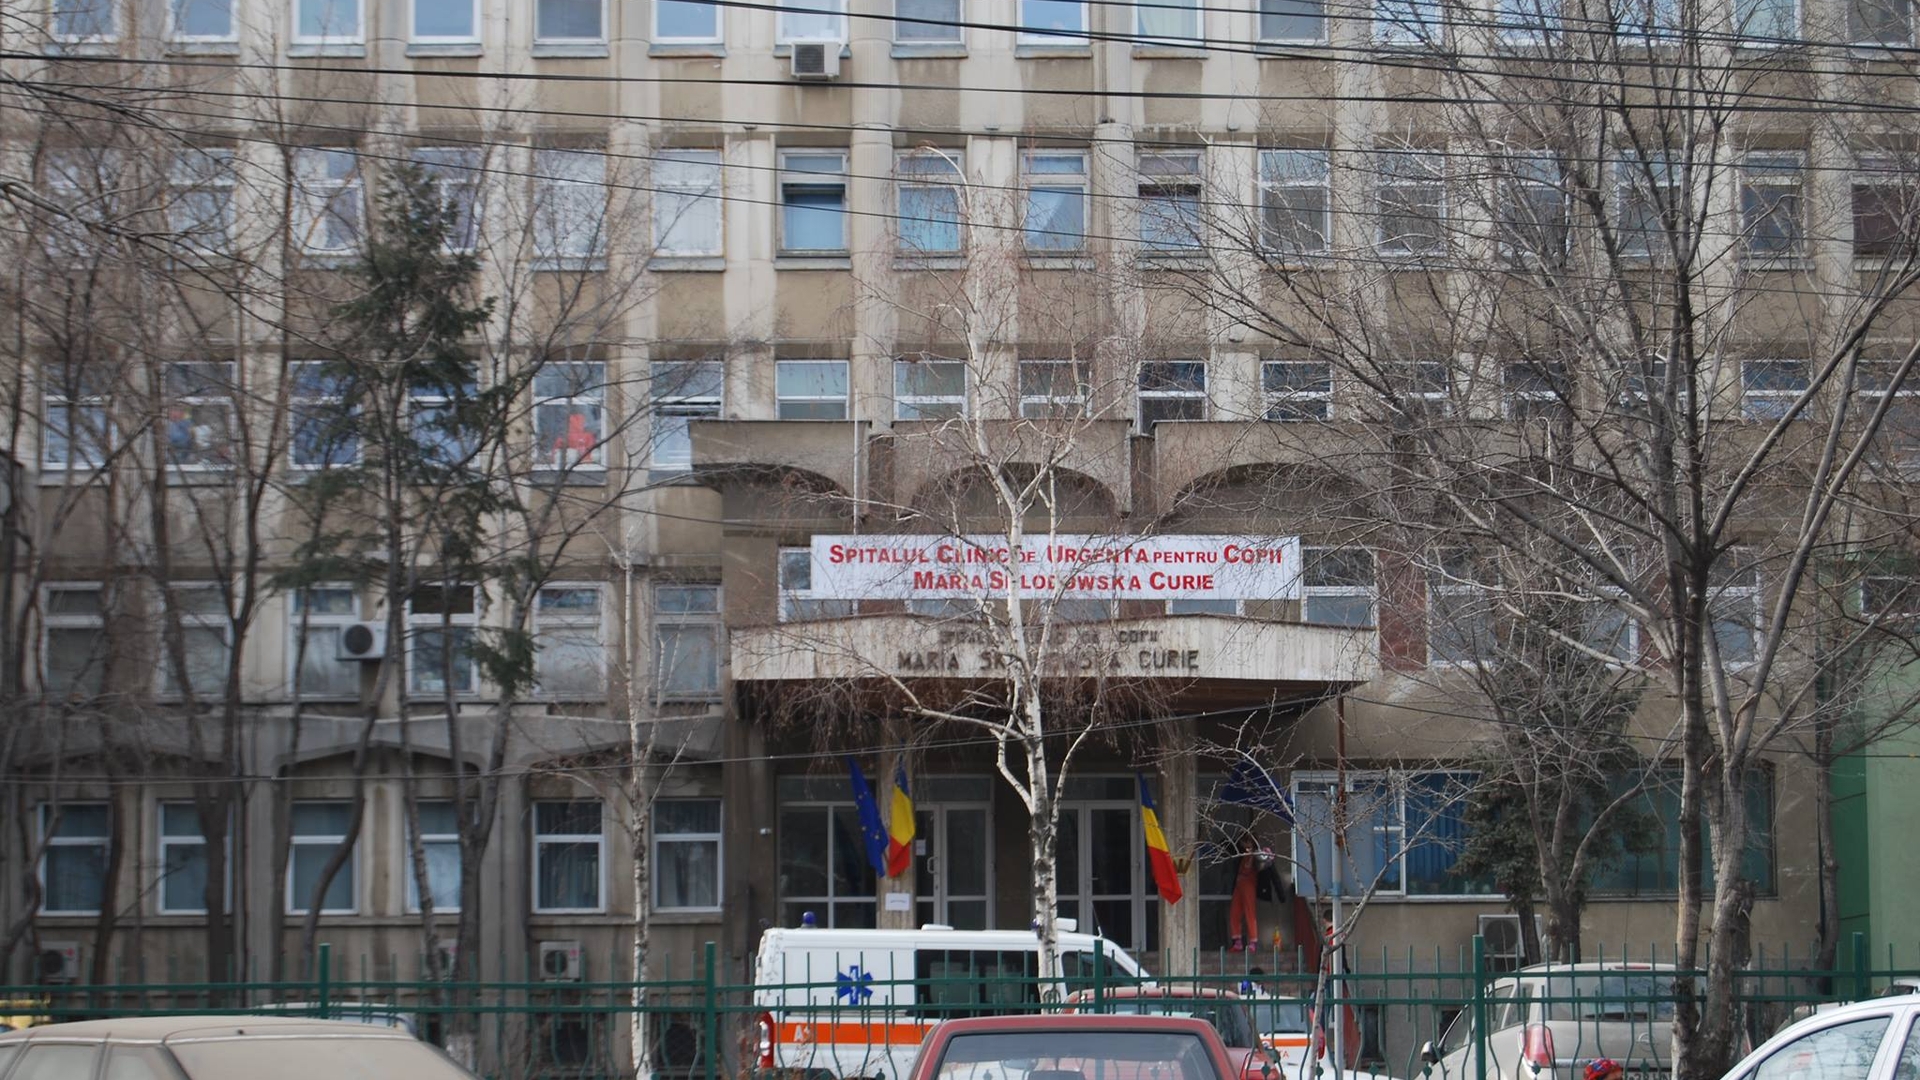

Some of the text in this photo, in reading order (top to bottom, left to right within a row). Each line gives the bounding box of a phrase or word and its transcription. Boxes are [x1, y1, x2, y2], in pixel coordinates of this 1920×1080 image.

[829, 544, 930, 564] SPITALUL
[1154, 551, 1218, 564] PENTRU
[1223, 544, 1283, 564] COPII
[1149, 571, 1214, 590] CURIE
[1139, 649, 1199, 669] CURIE
